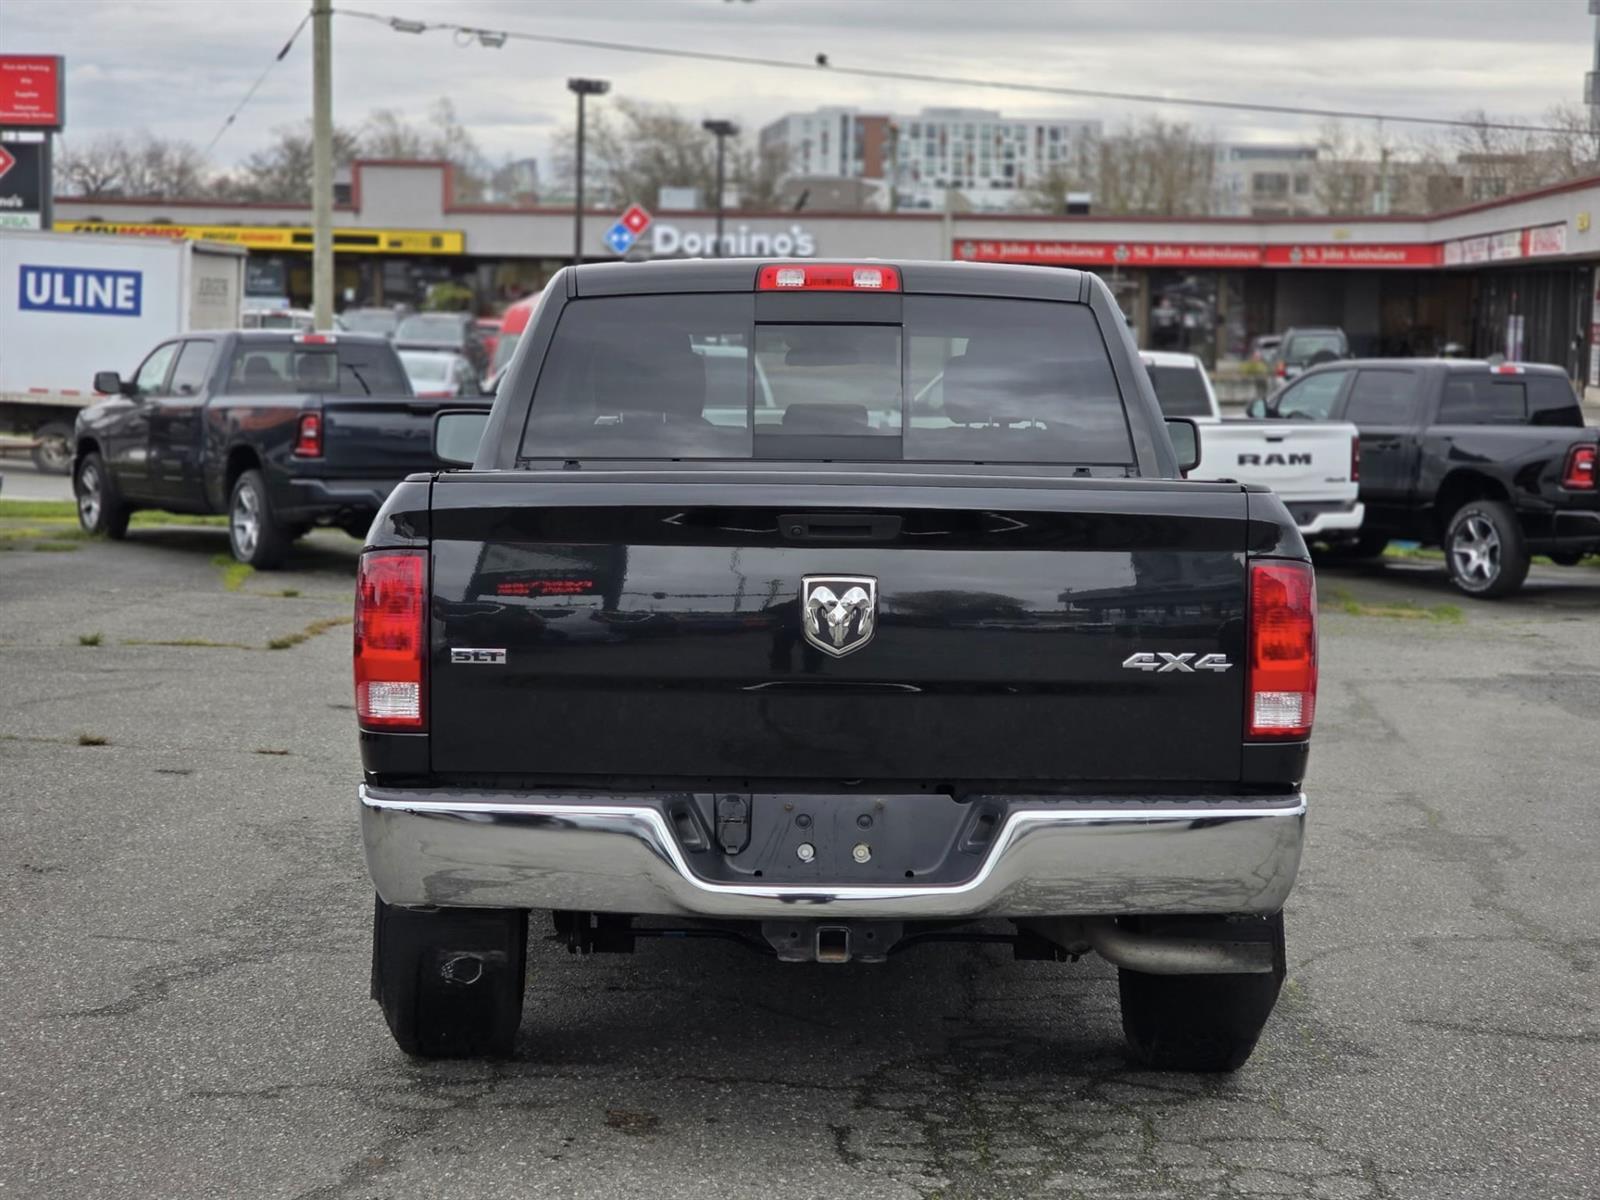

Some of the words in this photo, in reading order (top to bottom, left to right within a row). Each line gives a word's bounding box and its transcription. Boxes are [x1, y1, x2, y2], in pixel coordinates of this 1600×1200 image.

[652, 224, 816, 256] Domino's
[1000, 243, 1029, 256] John
[1035, 243, 1103, 257] Ambulance
[1153, 245, 1182, 258] John
[1187, 246, 1259, 259] Ambulance
[1320, 248, 1345, 260] John
[1349, 249, 1406, 260] Ambulance
[26, 272, 135, 309] ULINE
[1238, 453, 1312, 466] RAM
[453, 650, 506, 662] SLT
